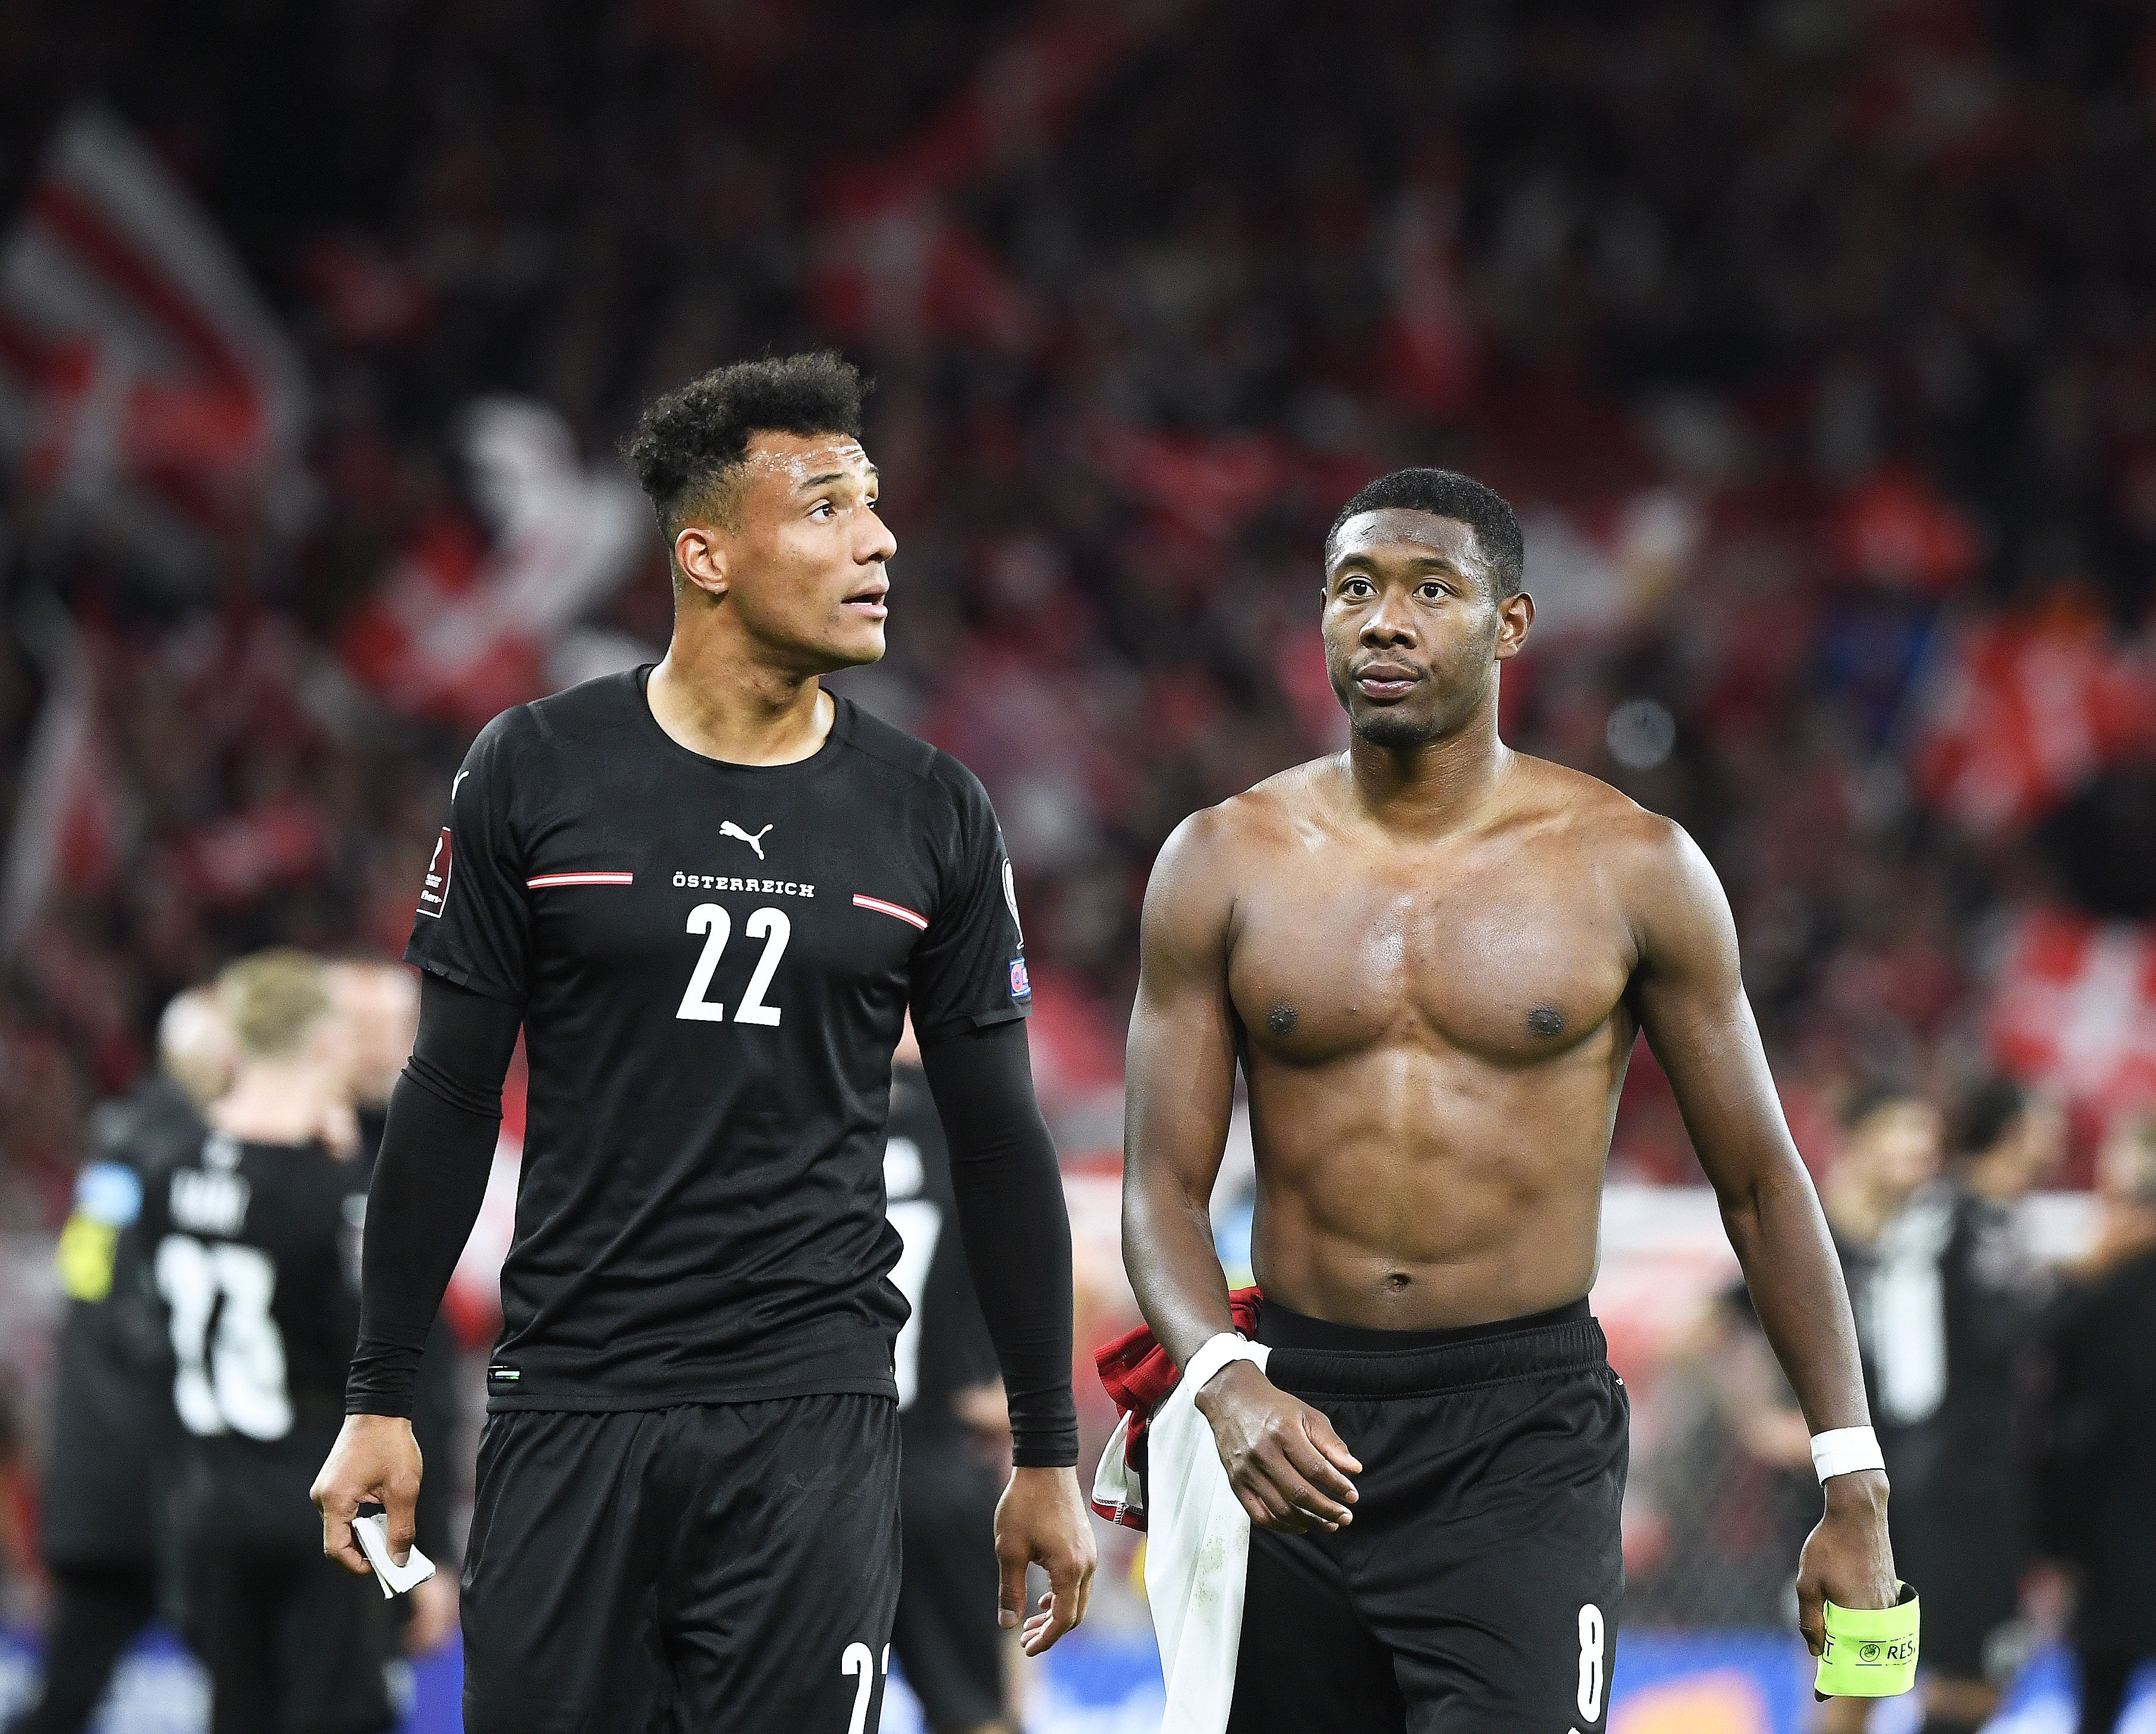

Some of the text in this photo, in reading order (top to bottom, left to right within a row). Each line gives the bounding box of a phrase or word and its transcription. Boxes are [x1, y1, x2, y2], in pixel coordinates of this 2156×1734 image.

[672, 871, 815, 898] ÖSTERREICH
[675, 903, 791, 1027] 22
[1577, 1603, 1604, 1723] 8
[1825, 1639, 1834, 1657] T
[1887, 1640, 1916, 1660] RES
[841, 1642, 891, 1734] 2
